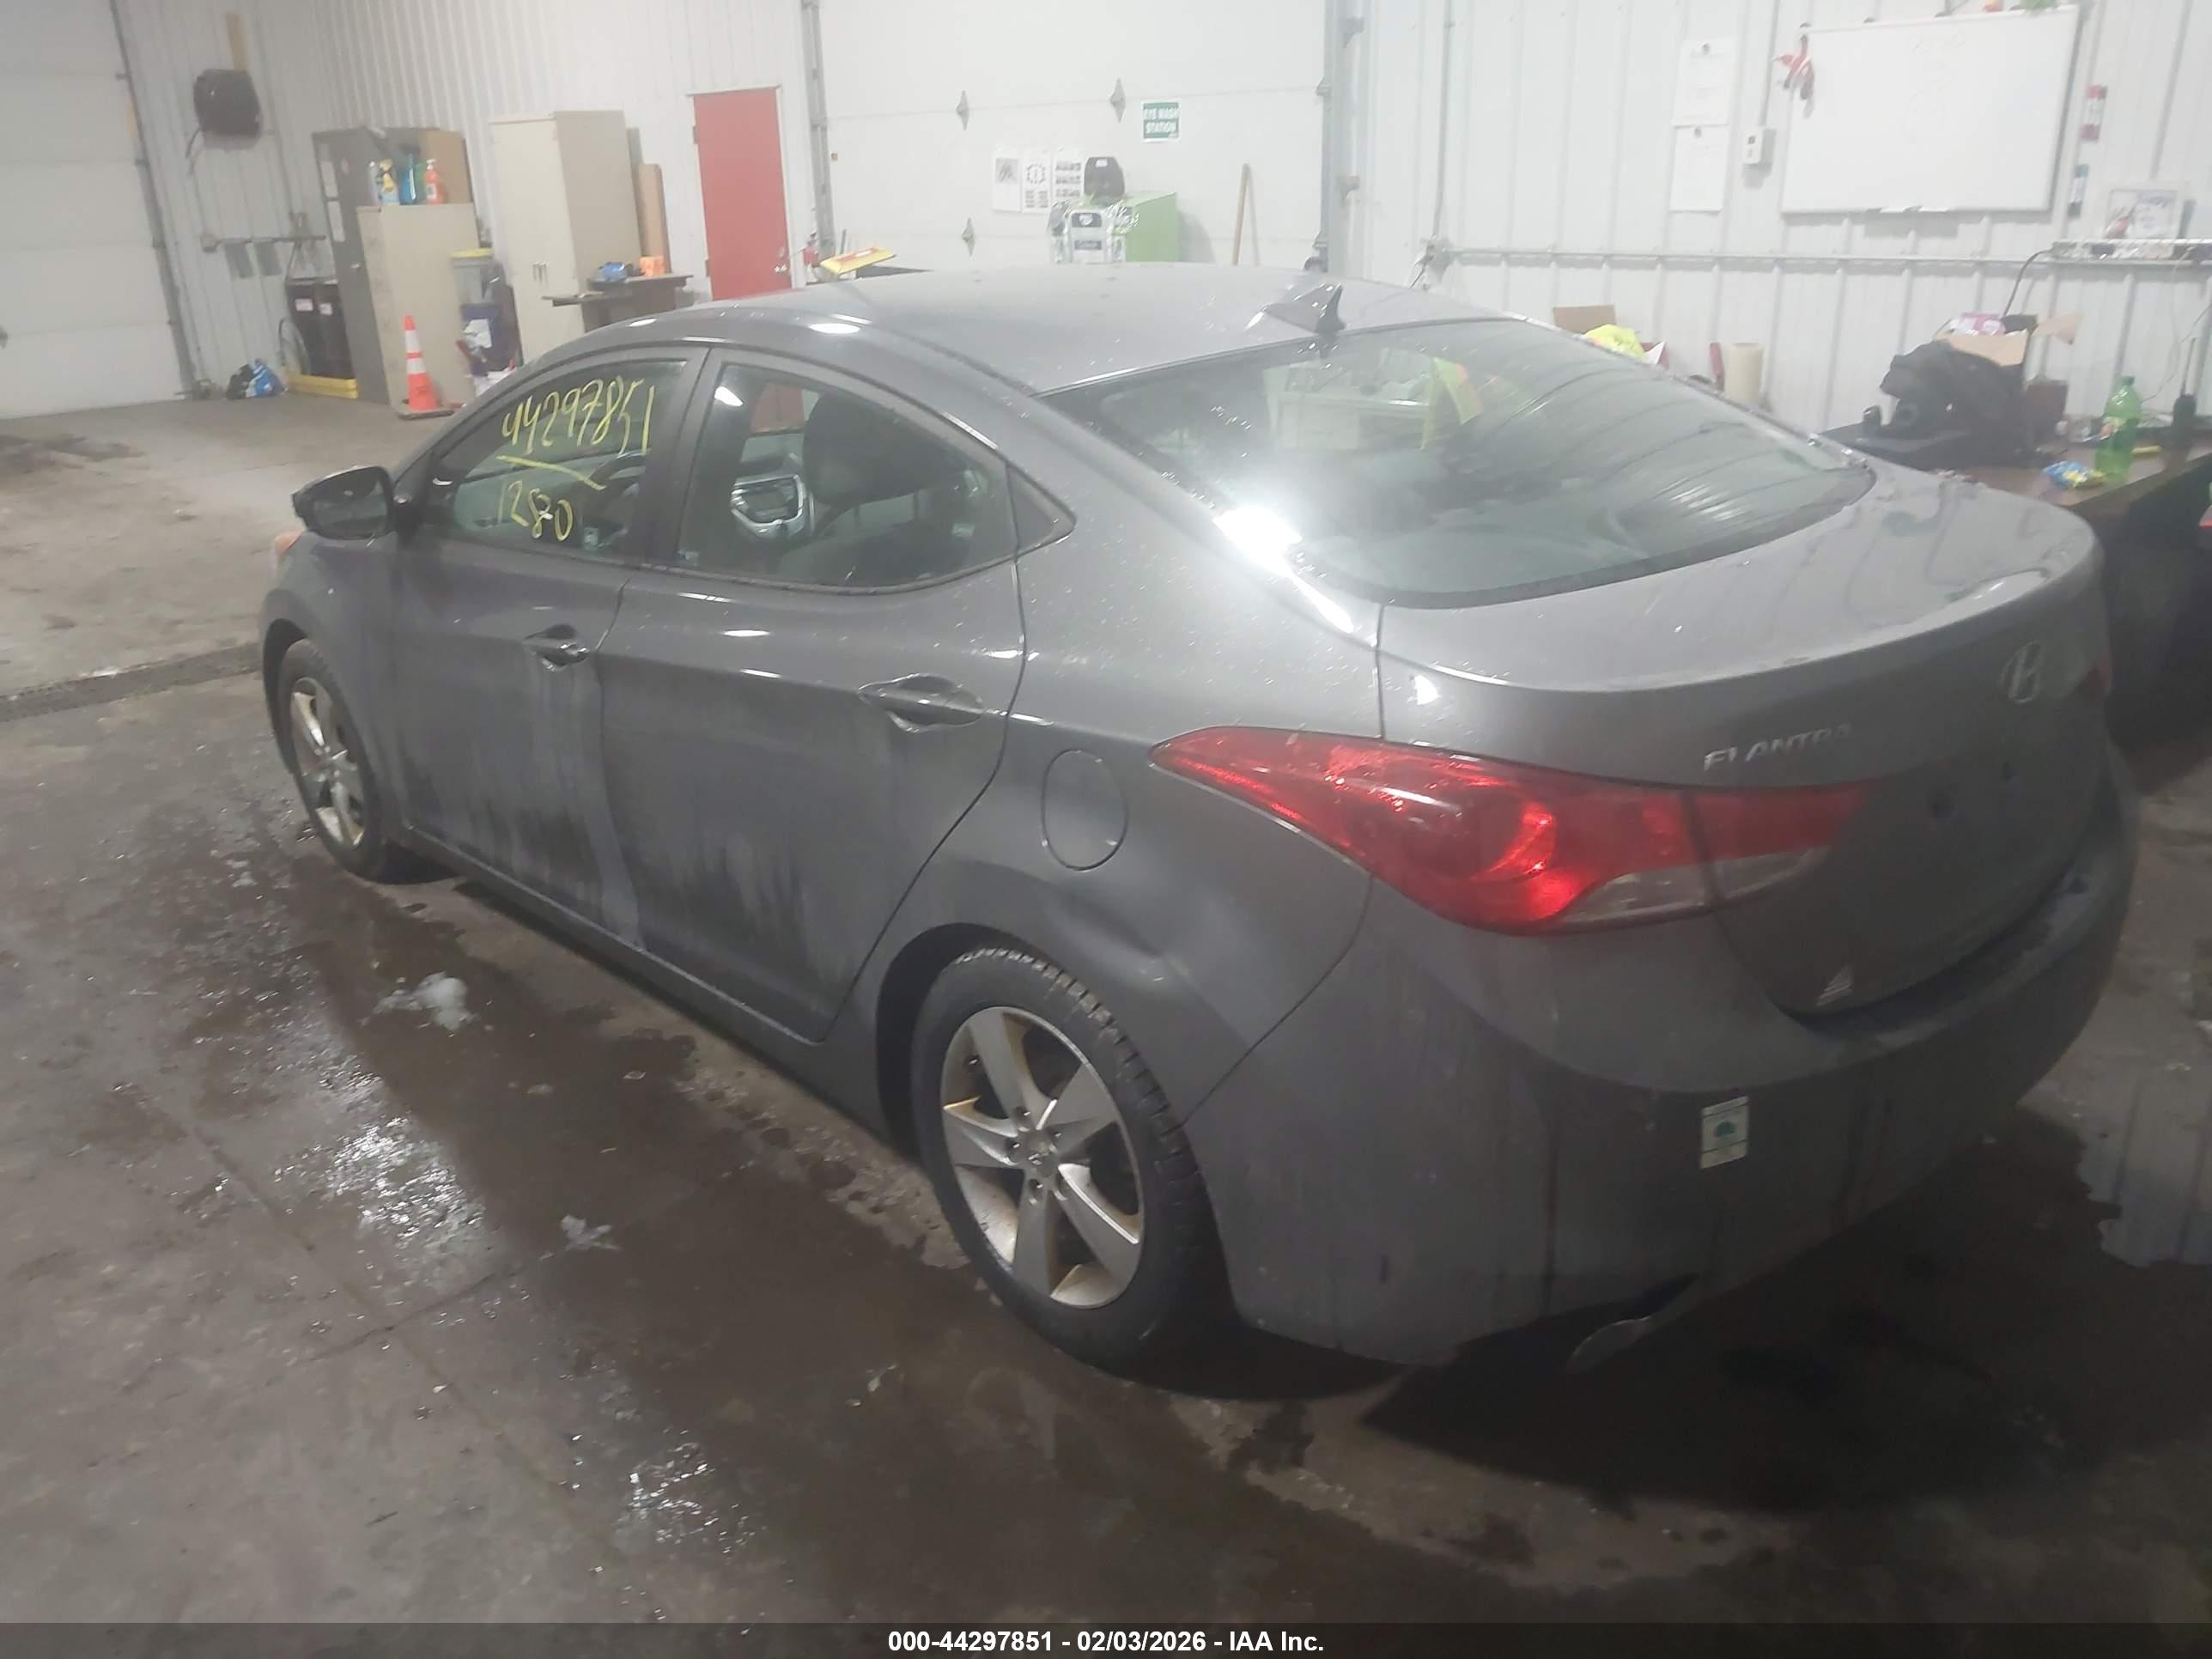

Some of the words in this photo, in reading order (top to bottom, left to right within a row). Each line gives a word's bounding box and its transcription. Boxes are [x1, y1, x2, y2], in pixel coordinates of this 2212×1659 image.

[501, 375, 656, 457] 44297851
[496, 479, 574, 542] 1280
[1704, 723, 1851, 770] ELANTRA
